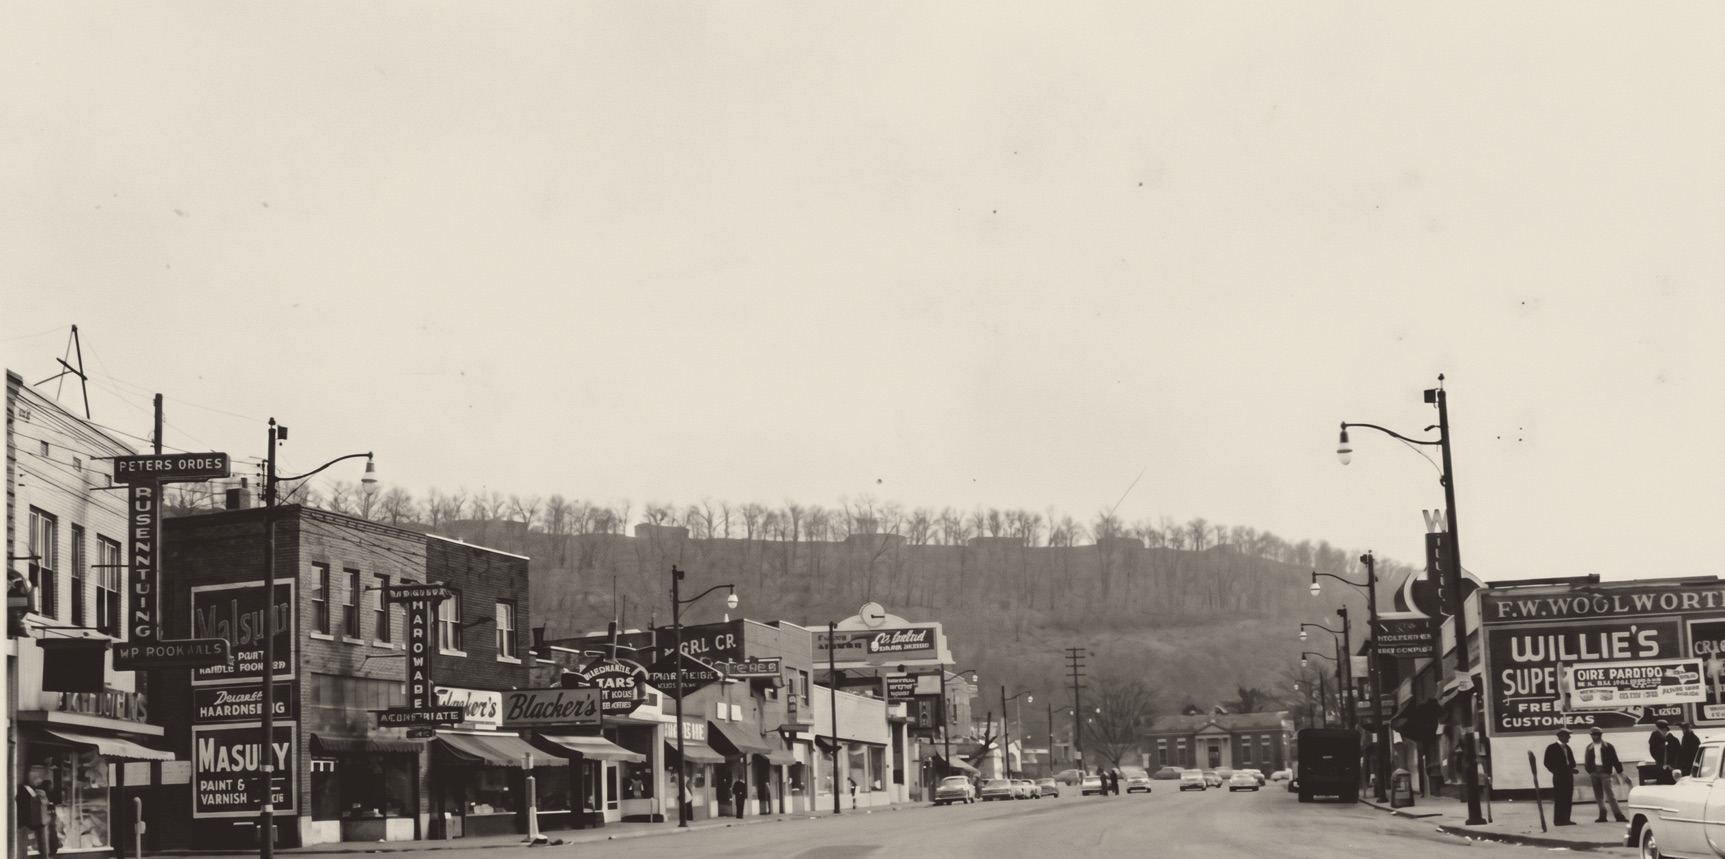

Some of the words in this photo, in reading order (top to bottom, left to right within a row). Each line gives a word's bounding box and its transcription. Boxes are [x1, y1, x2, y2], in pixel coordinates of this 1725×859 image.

[119, 459, 172, 472] PETERS
[178, 458, 222, 470] ORDES
[1511, 625, 1660, 662] WILLIE'S
[1502, 667, 1555, 695] SUPE
[506, 692, 597, 721] Blacker's
[199, 737, 289, 773] MASUY
[201, 779, 233, 791] PAINT
[237, 779, 245, 791] &
[201, 792, 247, 805] VARNISH
